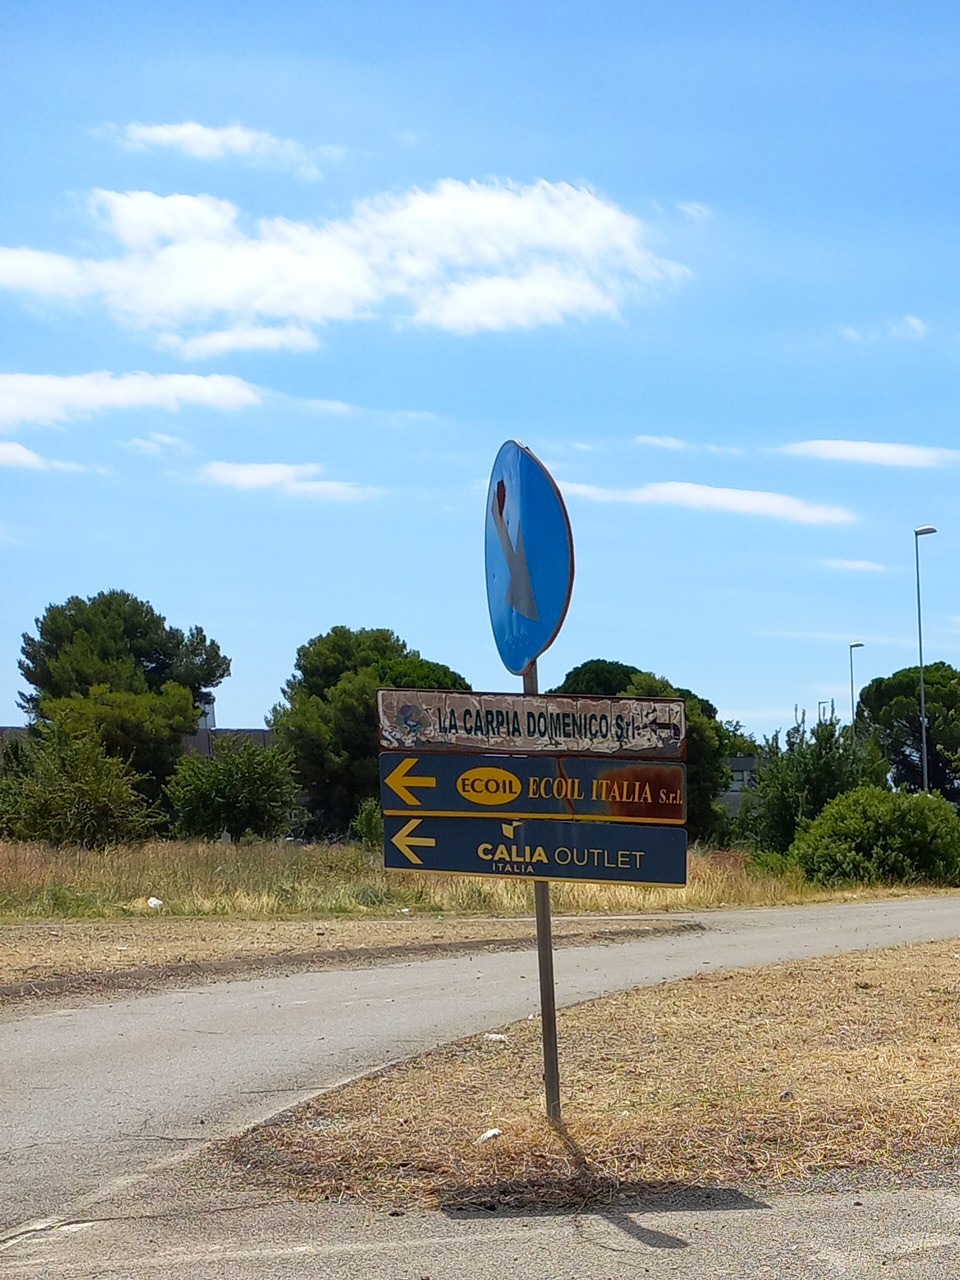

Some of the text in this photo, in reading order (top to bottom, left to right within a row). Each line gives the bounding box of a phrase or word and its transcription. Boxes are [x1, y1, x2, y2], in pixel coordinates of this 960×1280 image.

[437, 707, 458, 734] LA
[463, 708, 521, 737] CARPIA
[526, 711, 609, 739] DOMENICO
[461, 777, 518, 795] ECOIL
[528, 776, 683, 804] ECOIL ITALIA S.r.l.
[477, 843, 645, 869] CALIA OUTLET
[492, 862, 534, 874] ITALIA
